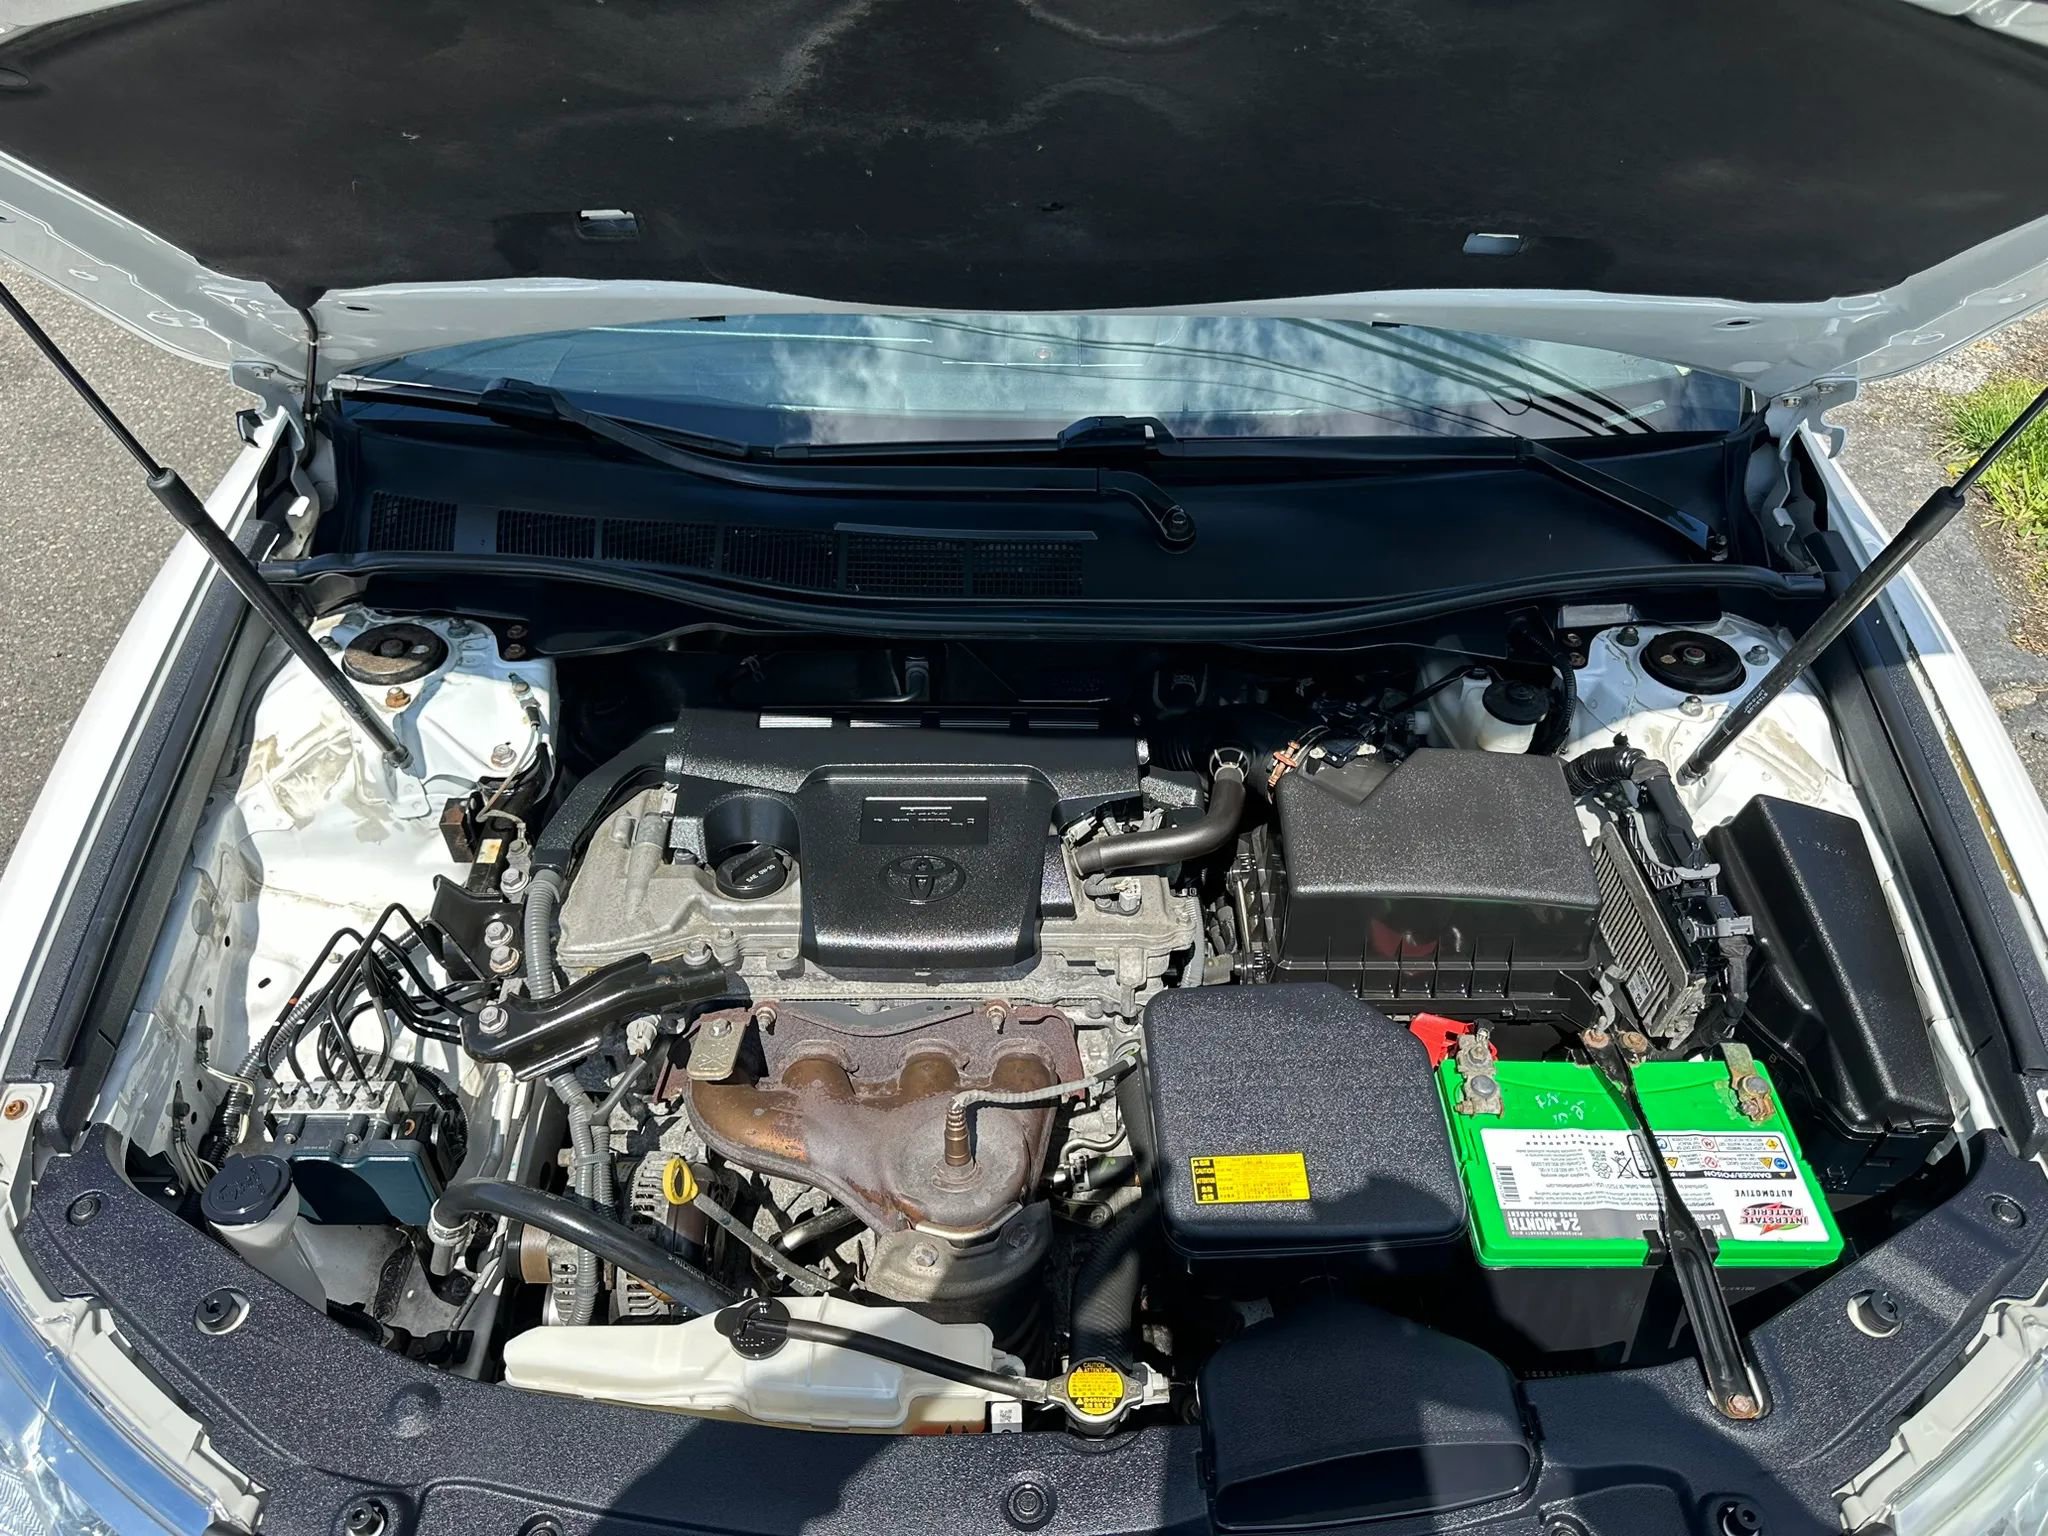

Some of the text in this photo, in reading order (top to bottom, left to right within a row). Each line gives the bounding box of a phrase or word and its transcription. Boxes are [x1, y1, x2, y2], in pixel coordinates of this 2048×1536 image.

[745, 873, 759, 883] SAE
[1704, 1170, 1772, 1179] DANGER/POISON
[1734, 1189, 1793, 1198] AUTOMOTIVE
[1743, 1208, 1803, 1216] BATTERIES
[1706, 1213, 1721, 1221] CCA
[1740, 1216, 1808, 1225] INTERSTATE
[1508, 1217, 1581, 1231] 24-MONTH
